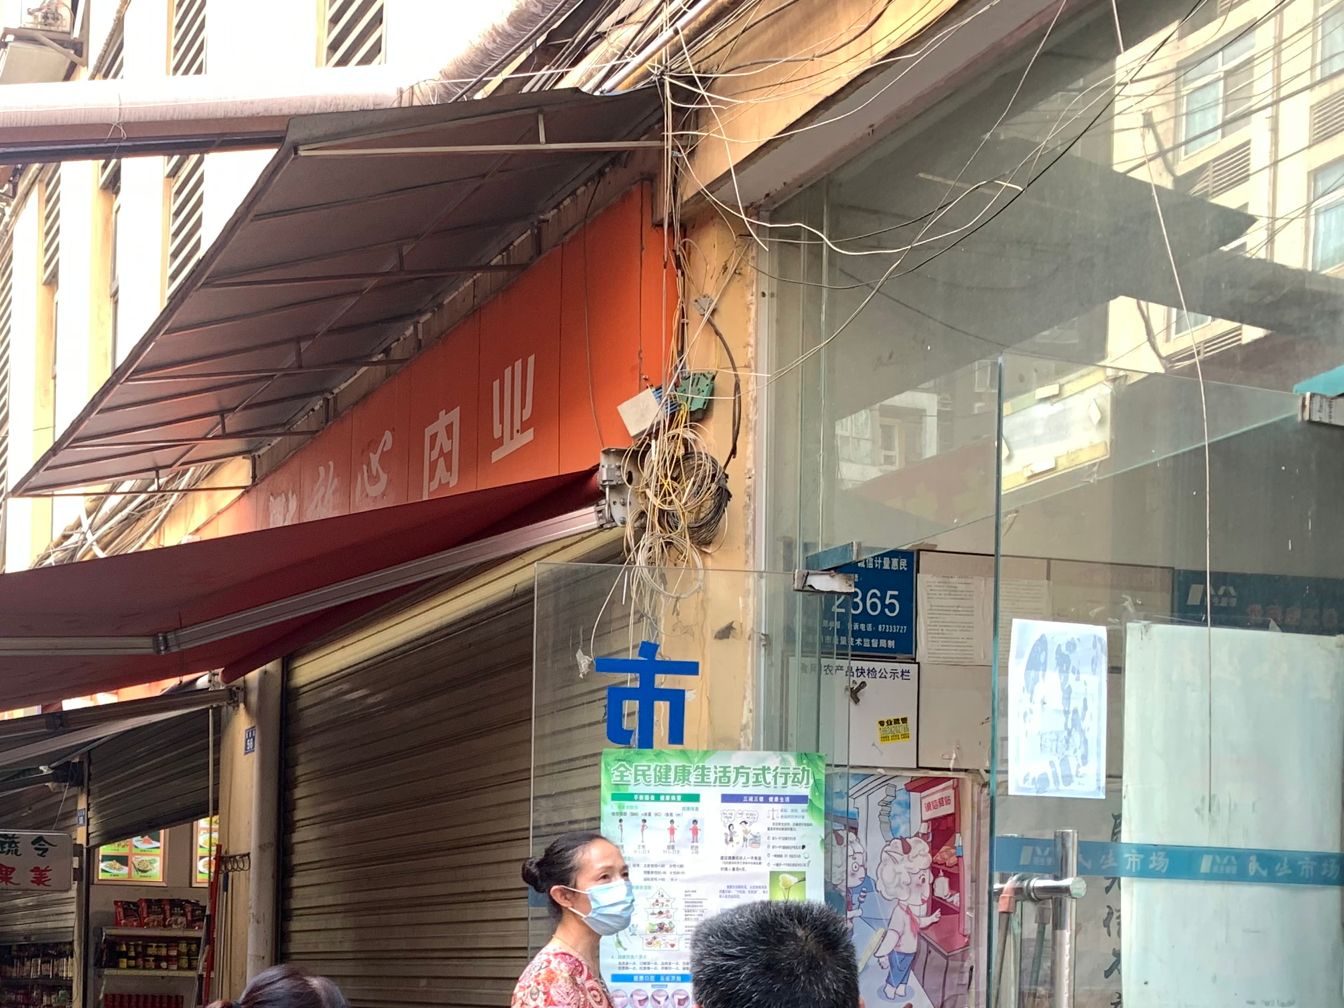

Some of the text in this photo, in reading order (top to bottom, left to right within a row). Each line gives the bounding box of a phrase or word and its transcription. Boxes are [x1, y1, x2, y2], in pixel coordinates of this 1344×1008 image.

[594, 640, 700, 750] 市
[611, 763, 812, 788] 全民健康生活方式行动
